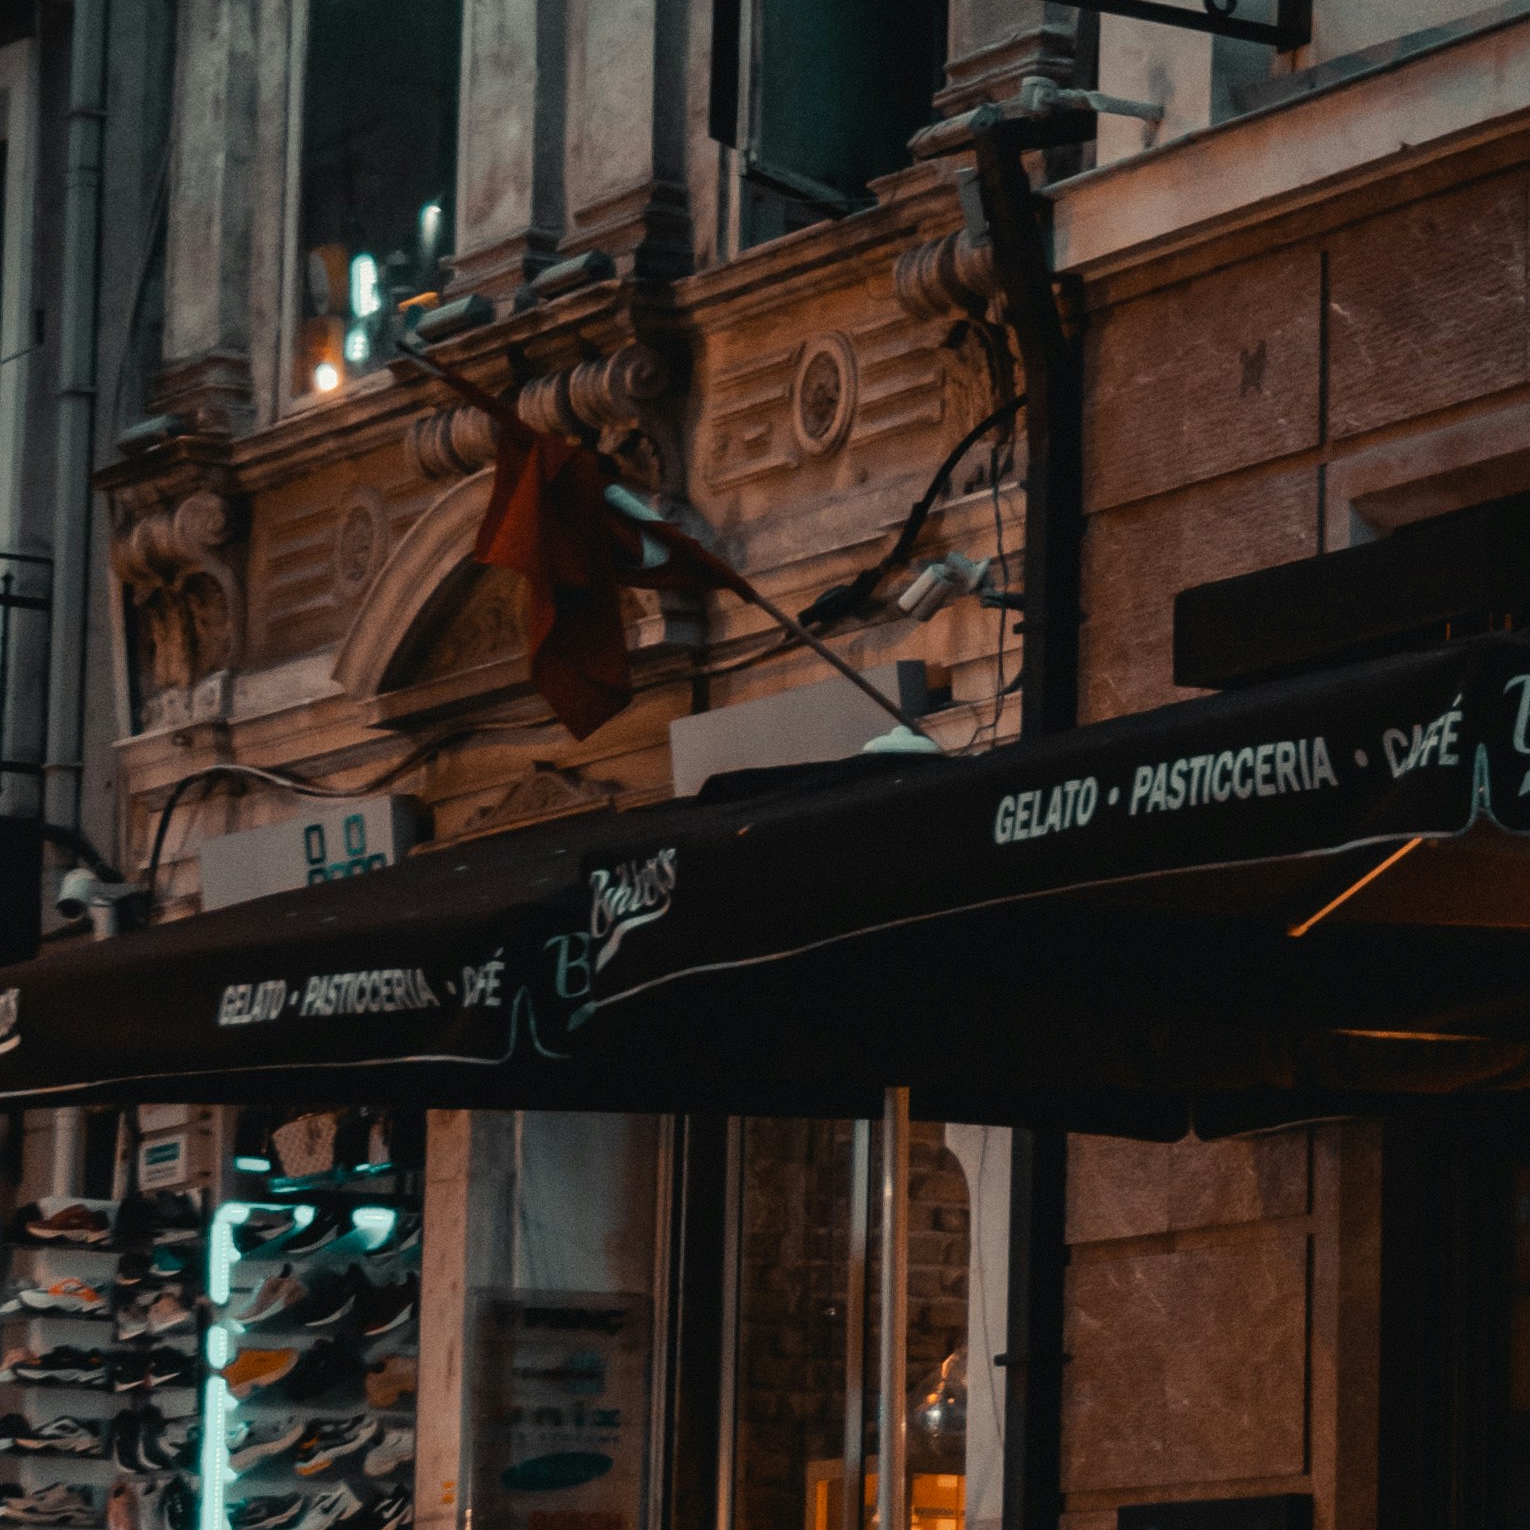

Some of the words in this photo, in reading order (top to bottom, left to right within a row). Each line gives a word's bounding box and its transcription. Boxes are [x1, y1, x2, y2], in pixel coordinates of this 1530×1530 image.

[994, 776, 1097, 845] GELATO
[1129, 736, 1338, 817] PASTICCERIA
[218, 979, 287, 1026] GELATO
[300, 967, 440, 1017] PASTICCERIA
